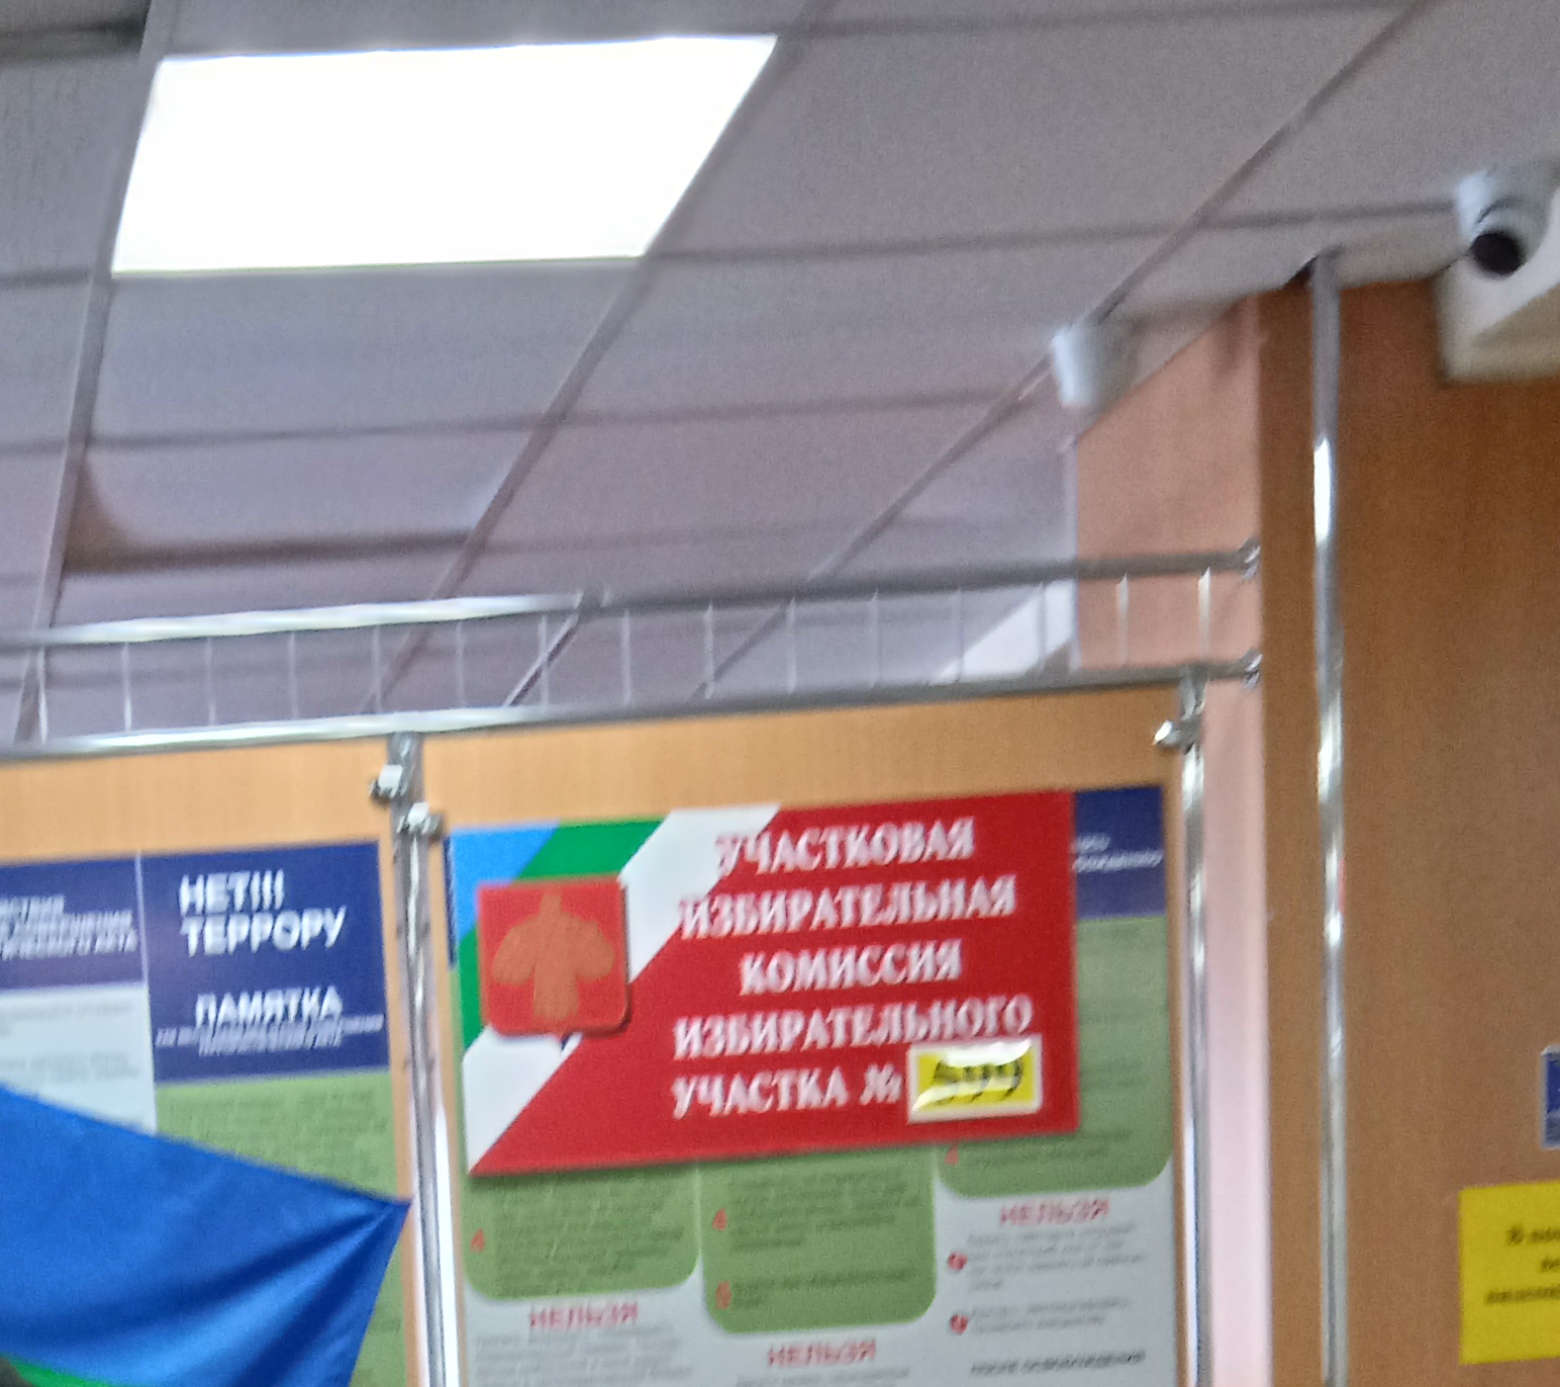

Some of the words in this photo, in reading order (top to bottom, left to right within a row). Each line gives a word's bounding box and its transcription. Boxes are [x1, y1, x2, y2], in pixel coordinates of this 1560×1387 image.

[715, 816, 975, 877] УЧАСТКОВАЯ
[180, 905, 346, 957] ТЕРРОРУ
[679, 874, 1017, 941] ИЗБИРАТЕЛЬНАЯ
[740, 938, 963, 997] КОМИССИЯ
[195, 985, 343, 1029] ПАМЯТКА
[673, 993, 1034, 1060] ИЗБИРАТЕЛЬНОГО
[672, 1066, 849, 1120] УЧАСТКА
